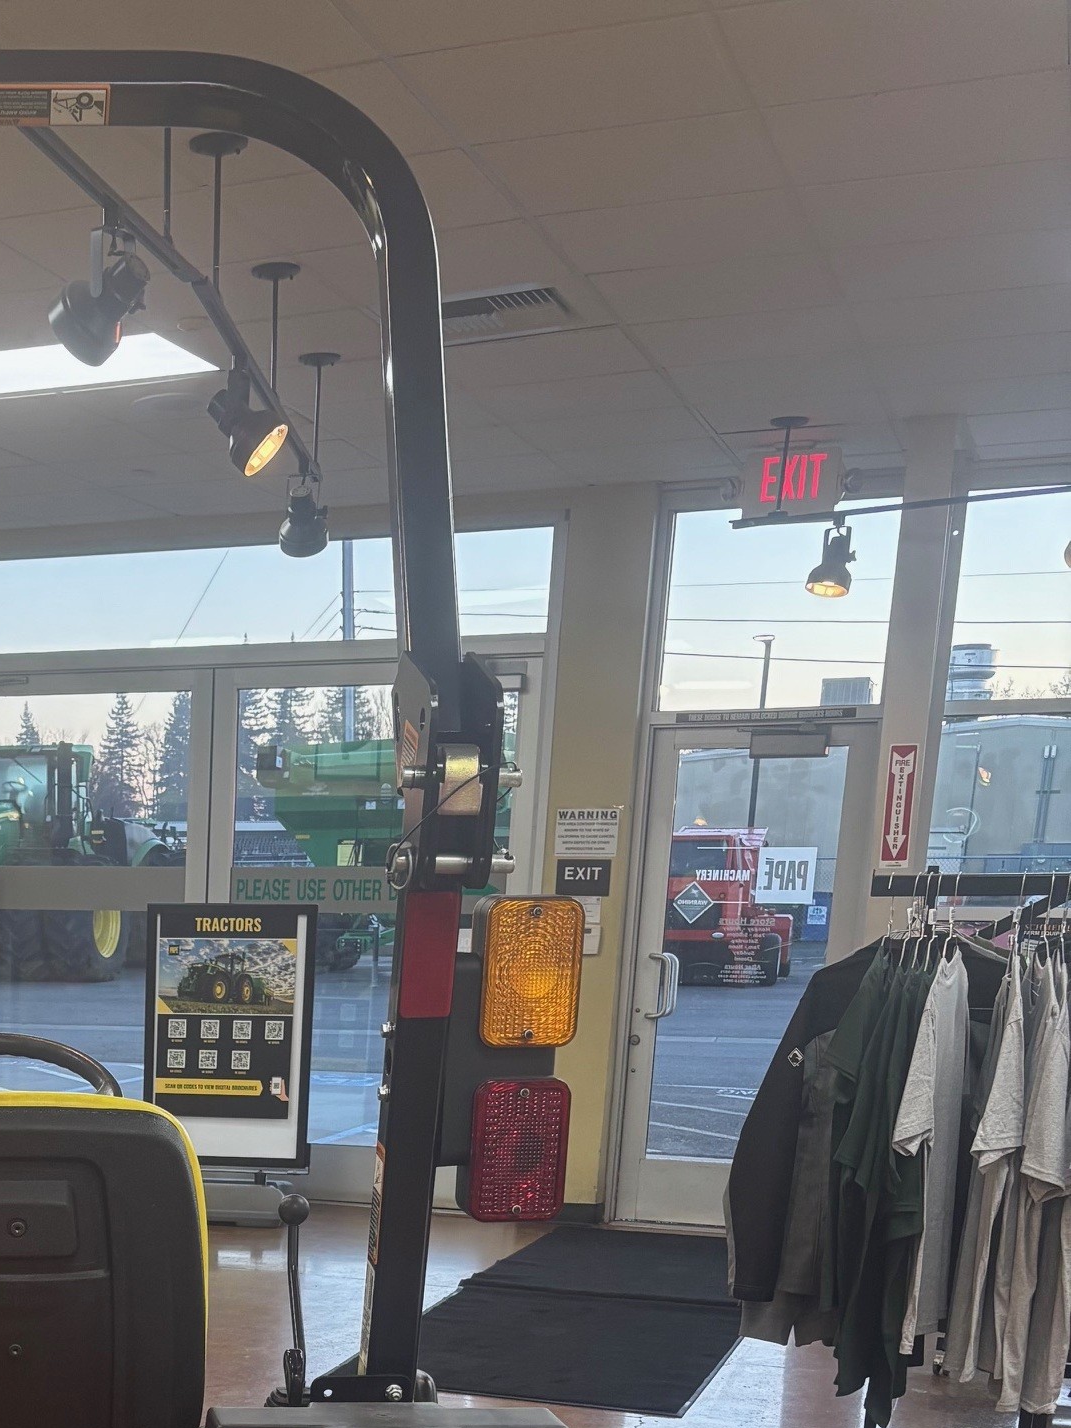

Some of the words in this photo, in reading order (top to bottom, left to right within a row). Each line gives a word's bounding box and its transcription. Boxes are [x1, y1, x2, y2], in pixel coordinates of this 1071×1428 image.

[759, 453, 827, 503] EXIT
[723, 713, 729, 721] TO
[558, 810, 618, 820] WARNING
[892, 766, 905, 850] EXTINGUISHER
[564, 866, 602, 881] EXIT
[236, 878, 290, 901] PLEASE
[297, 879, 326, 900] USE
[332, 879, 382, 901] OTHER
[195, 917, 262, 933] TRACTORS
